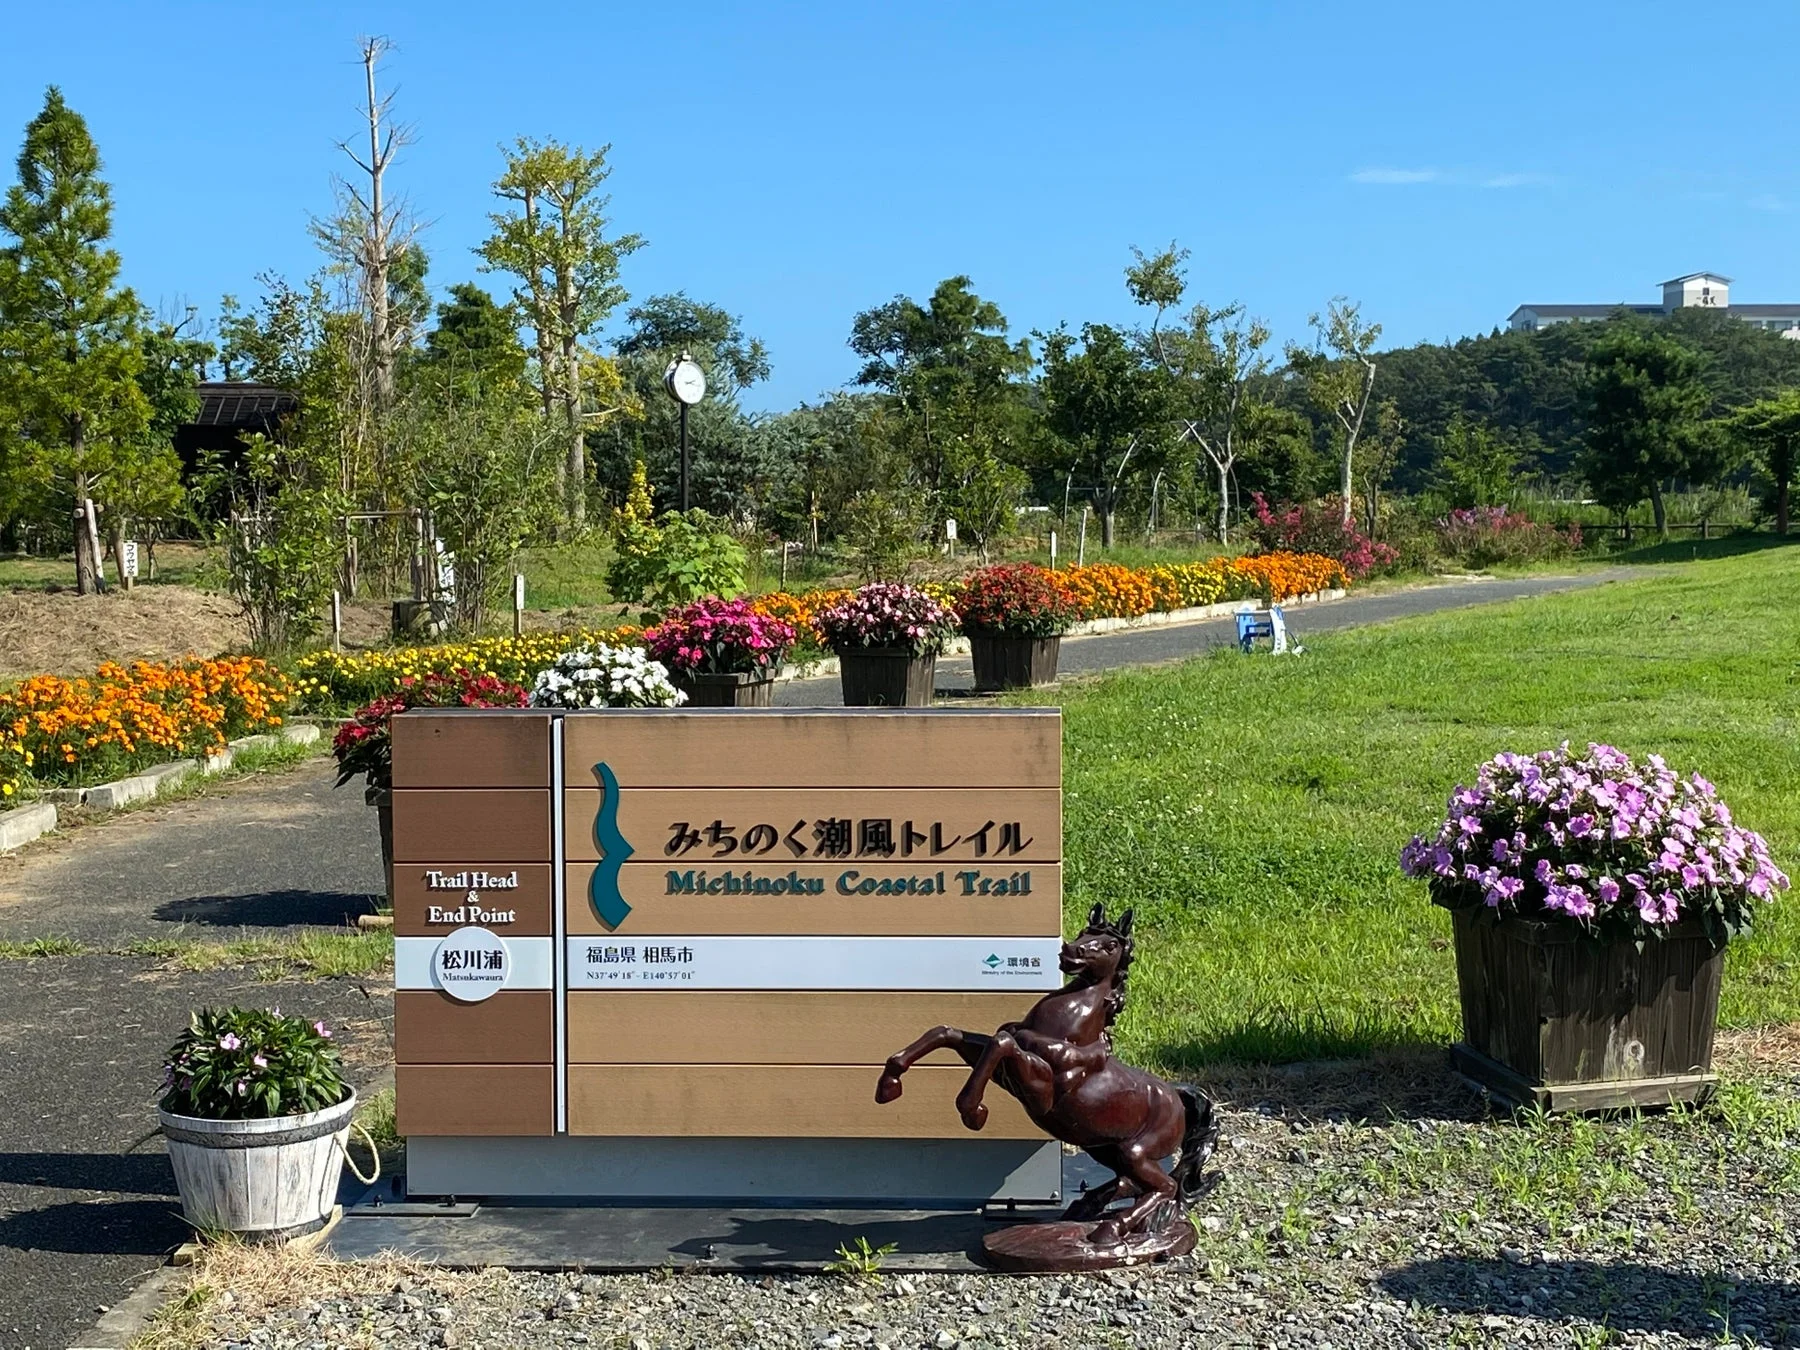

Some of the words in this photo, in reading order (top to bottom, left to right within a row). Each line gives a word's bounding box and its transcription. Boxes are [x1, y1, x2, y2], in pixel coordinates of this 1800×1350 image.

[664, 818, 1033, 858] みちのく潮風トレイル
[426, 870, 468, 888] Trail
[471, 871, 518, 888] Head
[664, 870, 825, 896] Michinoku
[836, 870, 946, 896] Coastal
[954, 870, 1032, 896] Trail
[467, 890, 479, 903] &
[428, 906, 465, 923] End
[468, 906, 516, 923] Point
[442, 950, 503, 970] 松川浦
[586, 946, 636, 963] 福島県
[643, 946, 694, 963] 相馬市
[1007, 957, 1041, 967] 環境省
[442, 972, 503, 981] Matsukawaura
